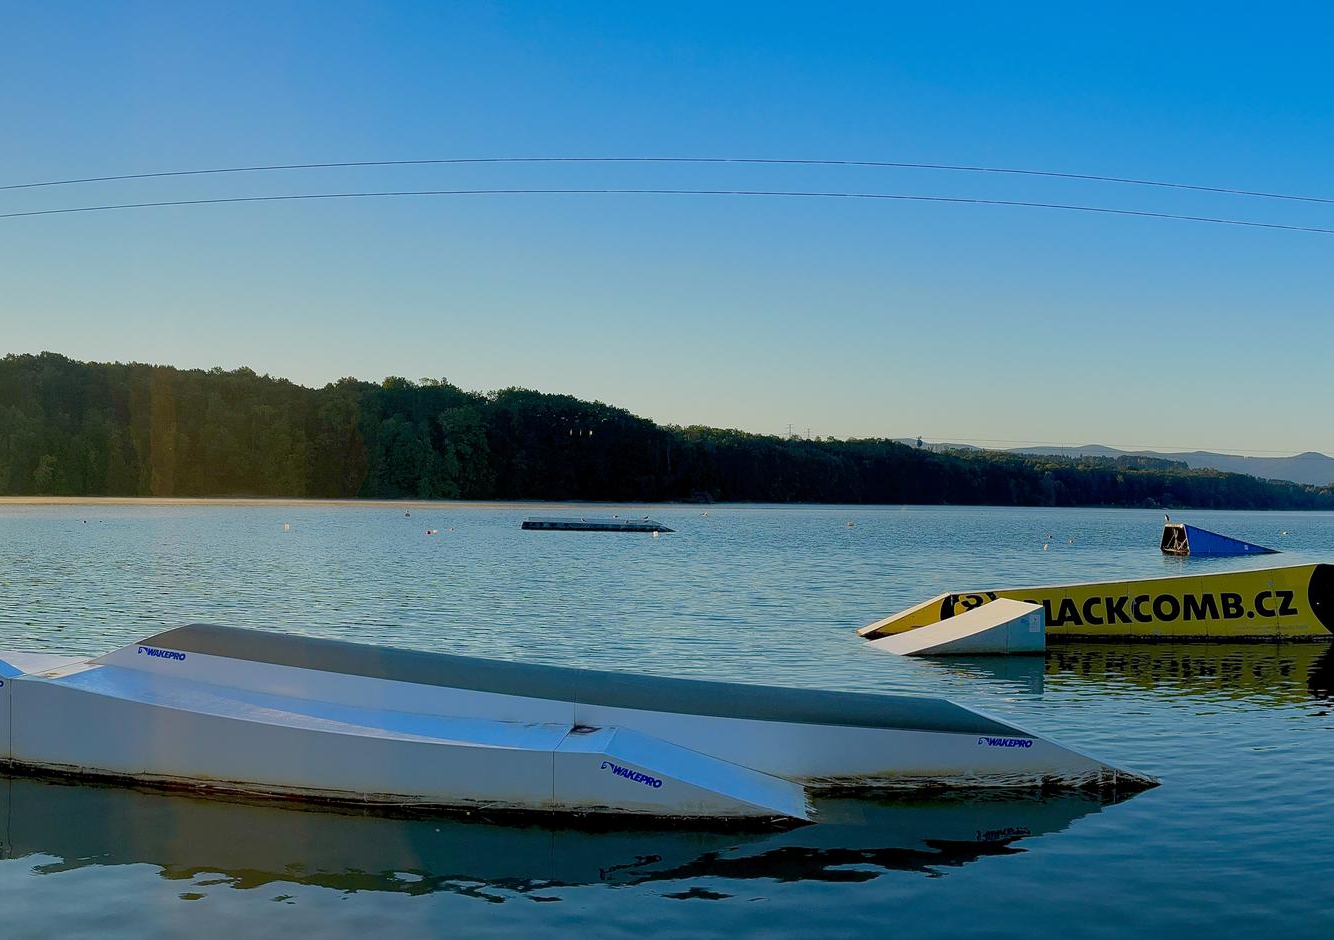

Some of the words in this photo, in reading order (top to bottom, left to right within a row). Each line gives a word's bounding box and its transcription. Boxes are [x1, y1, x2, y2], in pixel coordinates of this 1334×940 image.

[1024, 590, 1299, 627] LACKCOMB.CZ
[146, 647, 186, 661] WAKEPRO
[987, 737, 1033, 748] WAKEPRO
[611, 764, 663, 789] WAKEPRO
